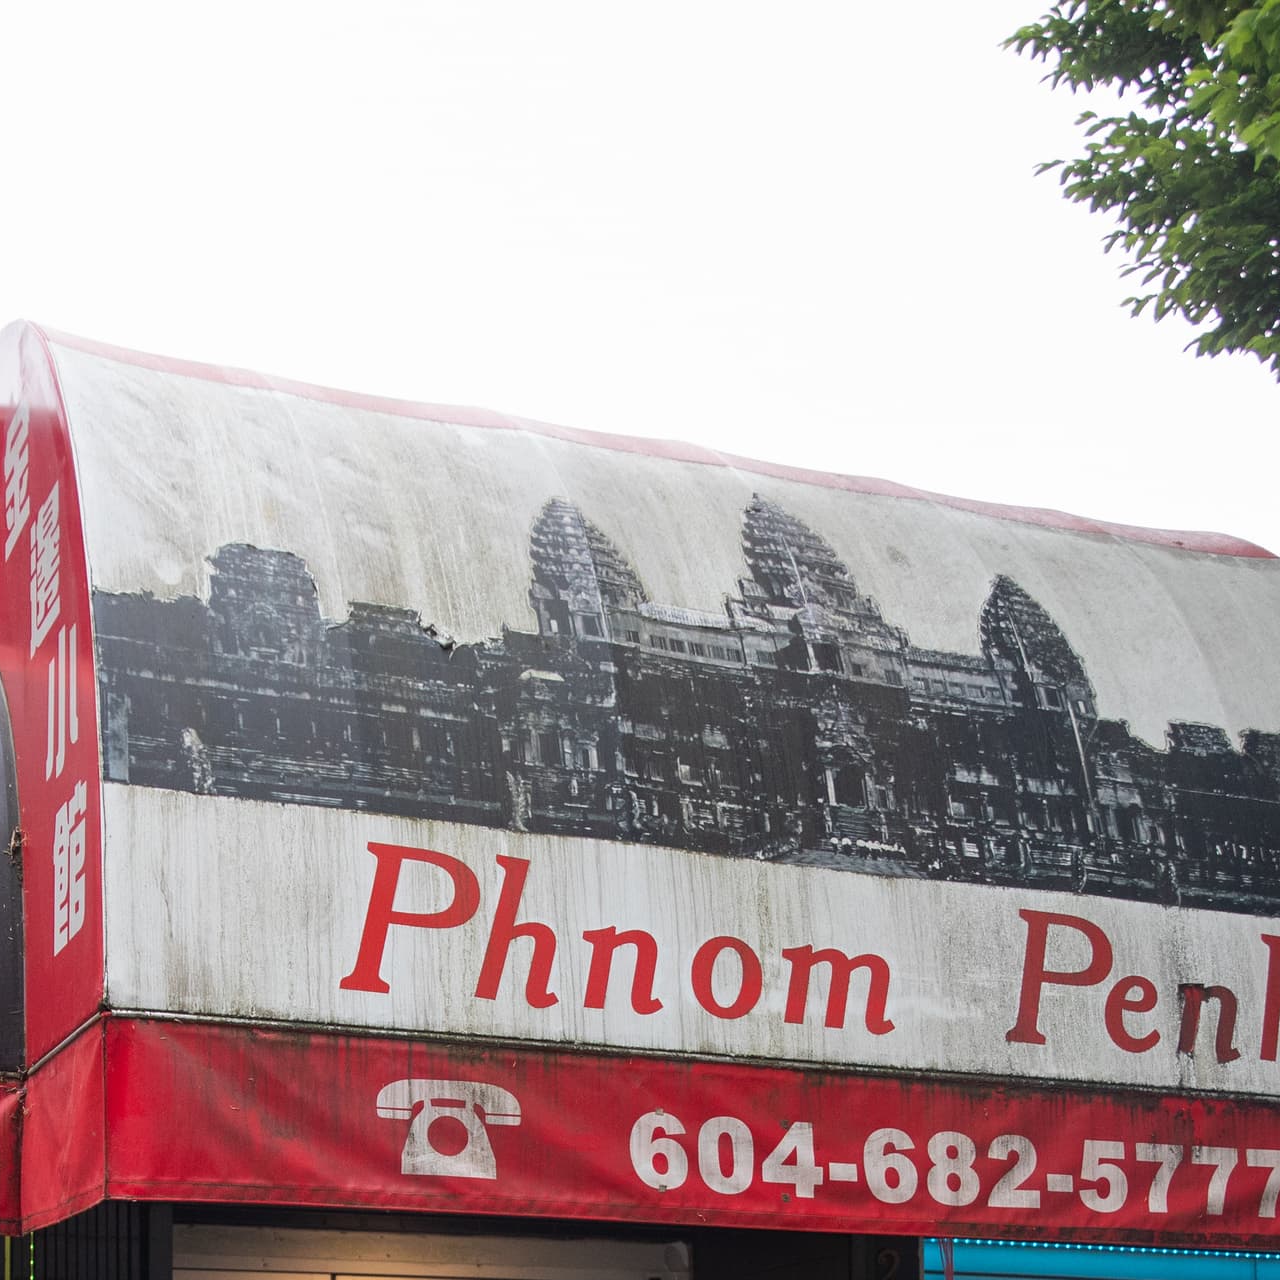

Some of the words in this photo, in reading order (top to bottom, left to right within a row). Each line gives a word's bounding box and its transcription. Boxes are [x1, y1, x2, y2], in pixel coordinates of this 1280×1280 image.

[3, 396, 88, 958] 金邊小館
[340, 842, 895, 1035] Phnom
